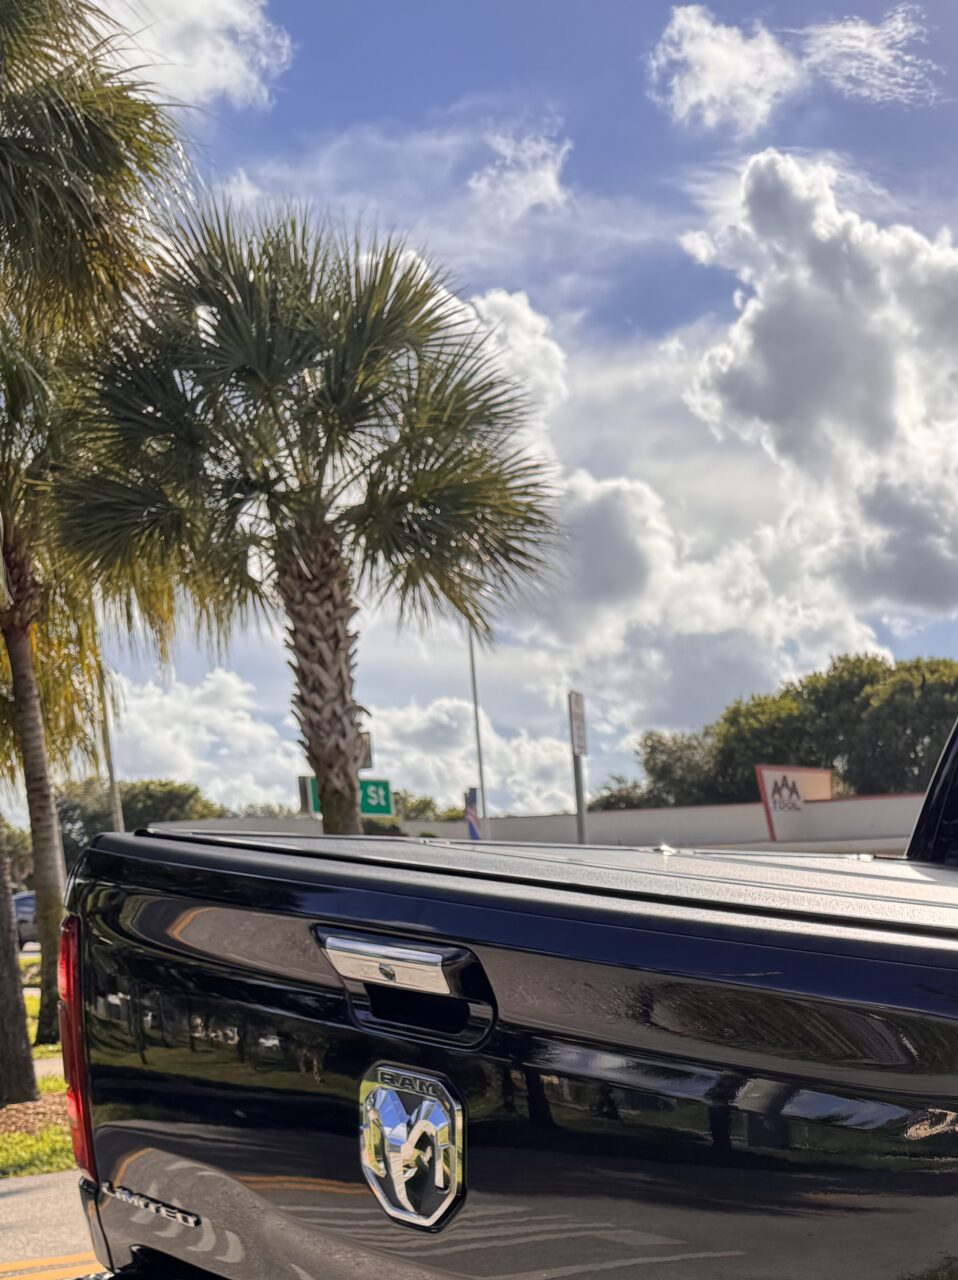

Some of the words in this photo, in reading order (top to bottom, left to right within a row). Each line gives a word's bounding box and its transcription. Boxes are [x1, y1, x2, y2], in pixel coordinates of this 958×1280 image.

[367, 785, 386, 806] St
[772, 800, 802, 811] TOOL
[377, 1070, 439, 1096] RAM
